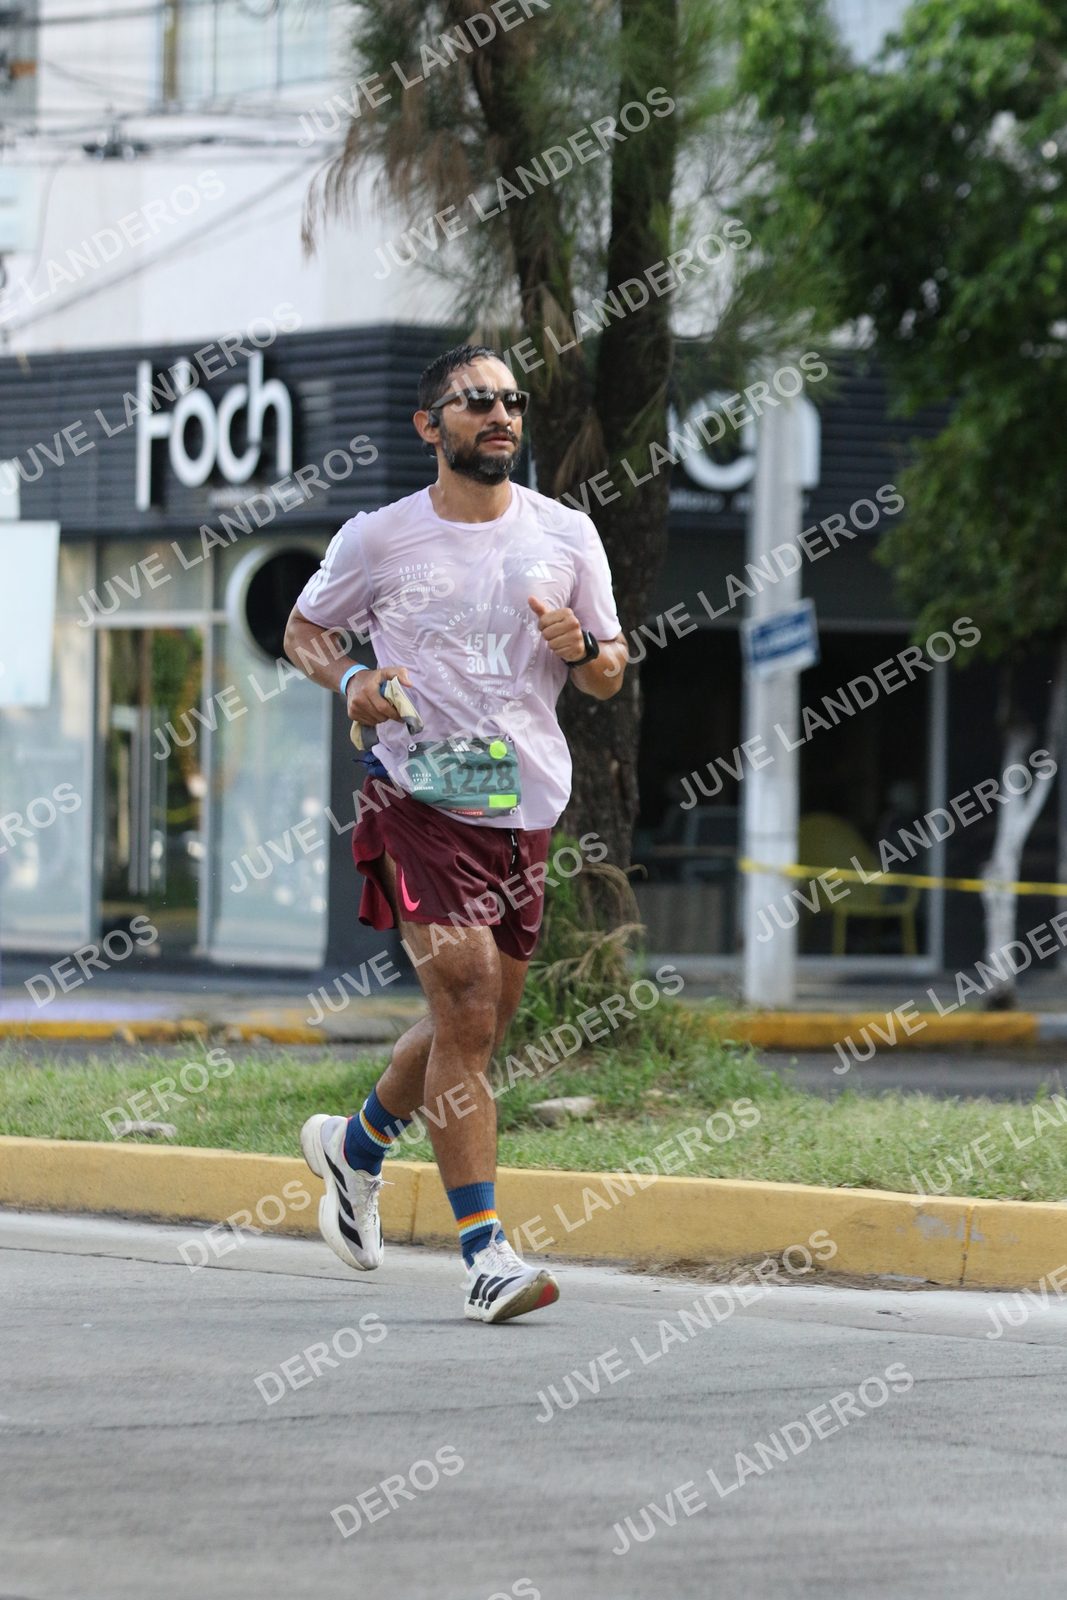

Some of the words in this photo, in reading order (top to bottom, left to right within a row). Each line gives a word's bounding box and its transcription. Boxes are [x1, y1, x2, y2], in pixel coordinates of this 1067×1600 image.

[466, 656, 486, 675] 30
[487, 633, 513, 676] K
[442, 761, 516, 794] 1228
